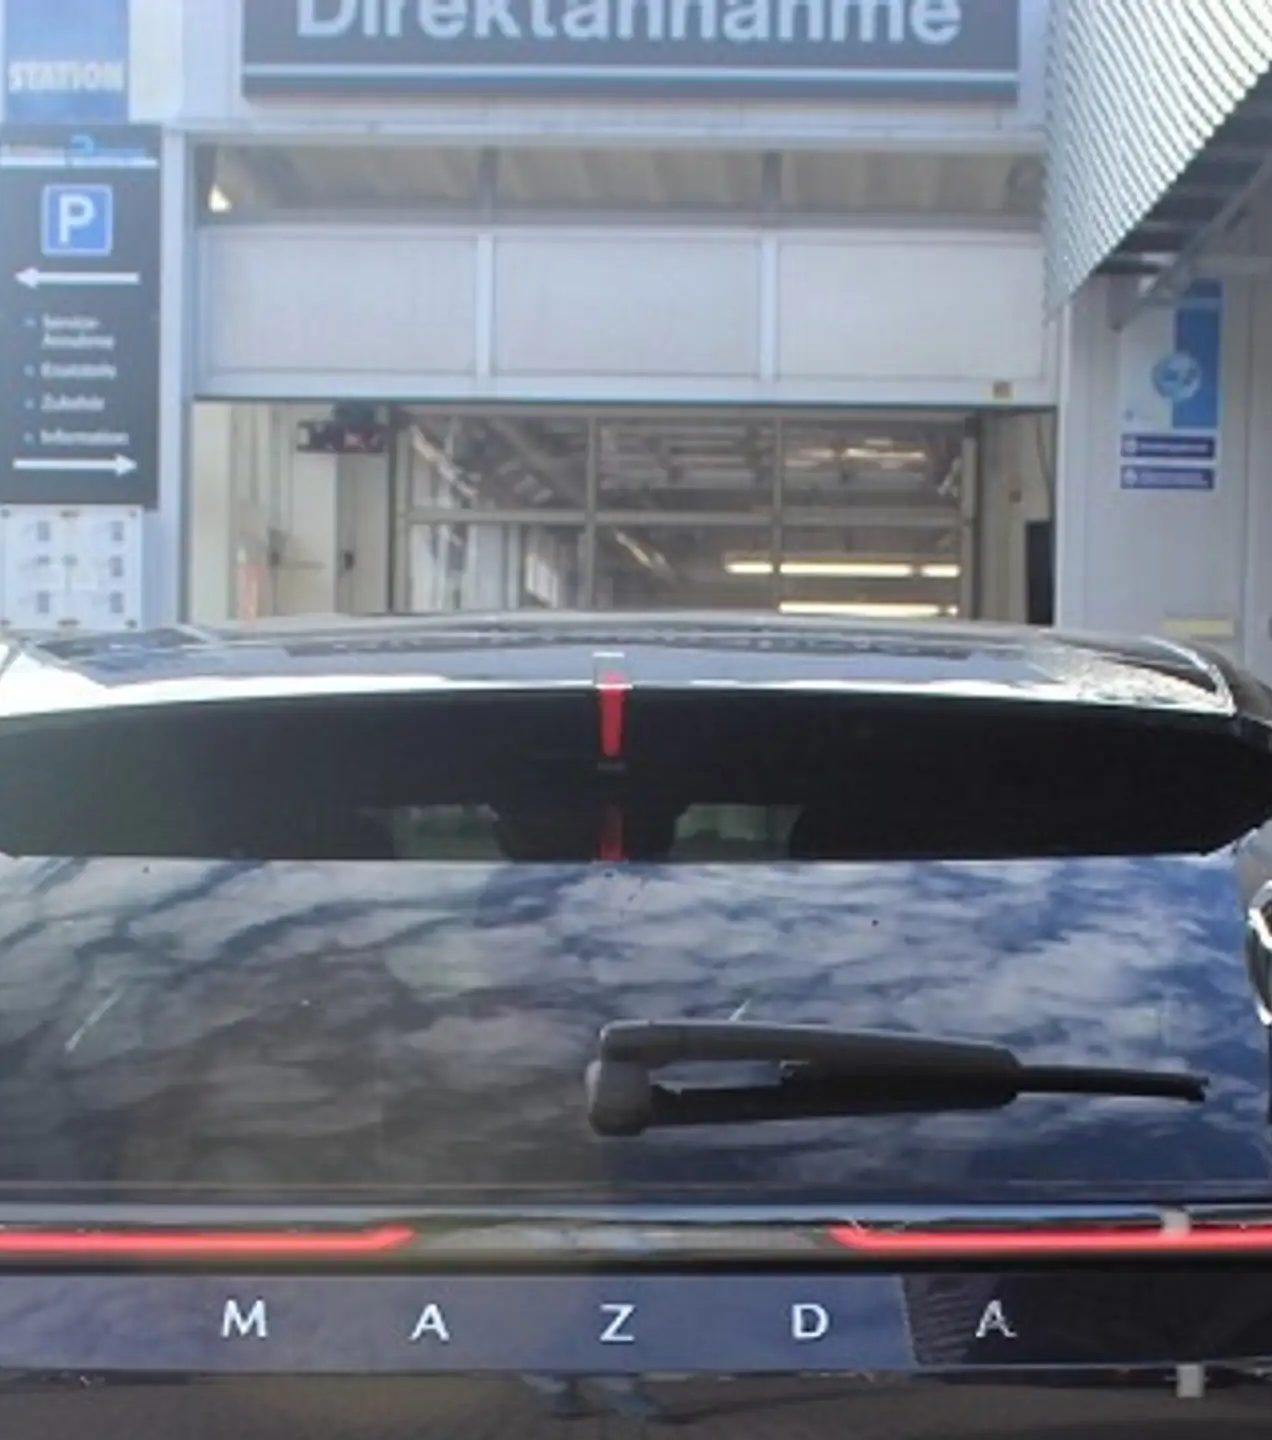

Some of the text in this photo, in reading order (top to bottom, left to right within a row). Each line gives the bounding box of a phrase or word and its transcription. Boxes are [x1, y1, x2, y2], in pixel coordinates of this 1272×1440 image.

[7, 61, 124, 92] STATION
[59, 194, 96, 244] P
[221, 1298, 1017, 1342] MAZDA
